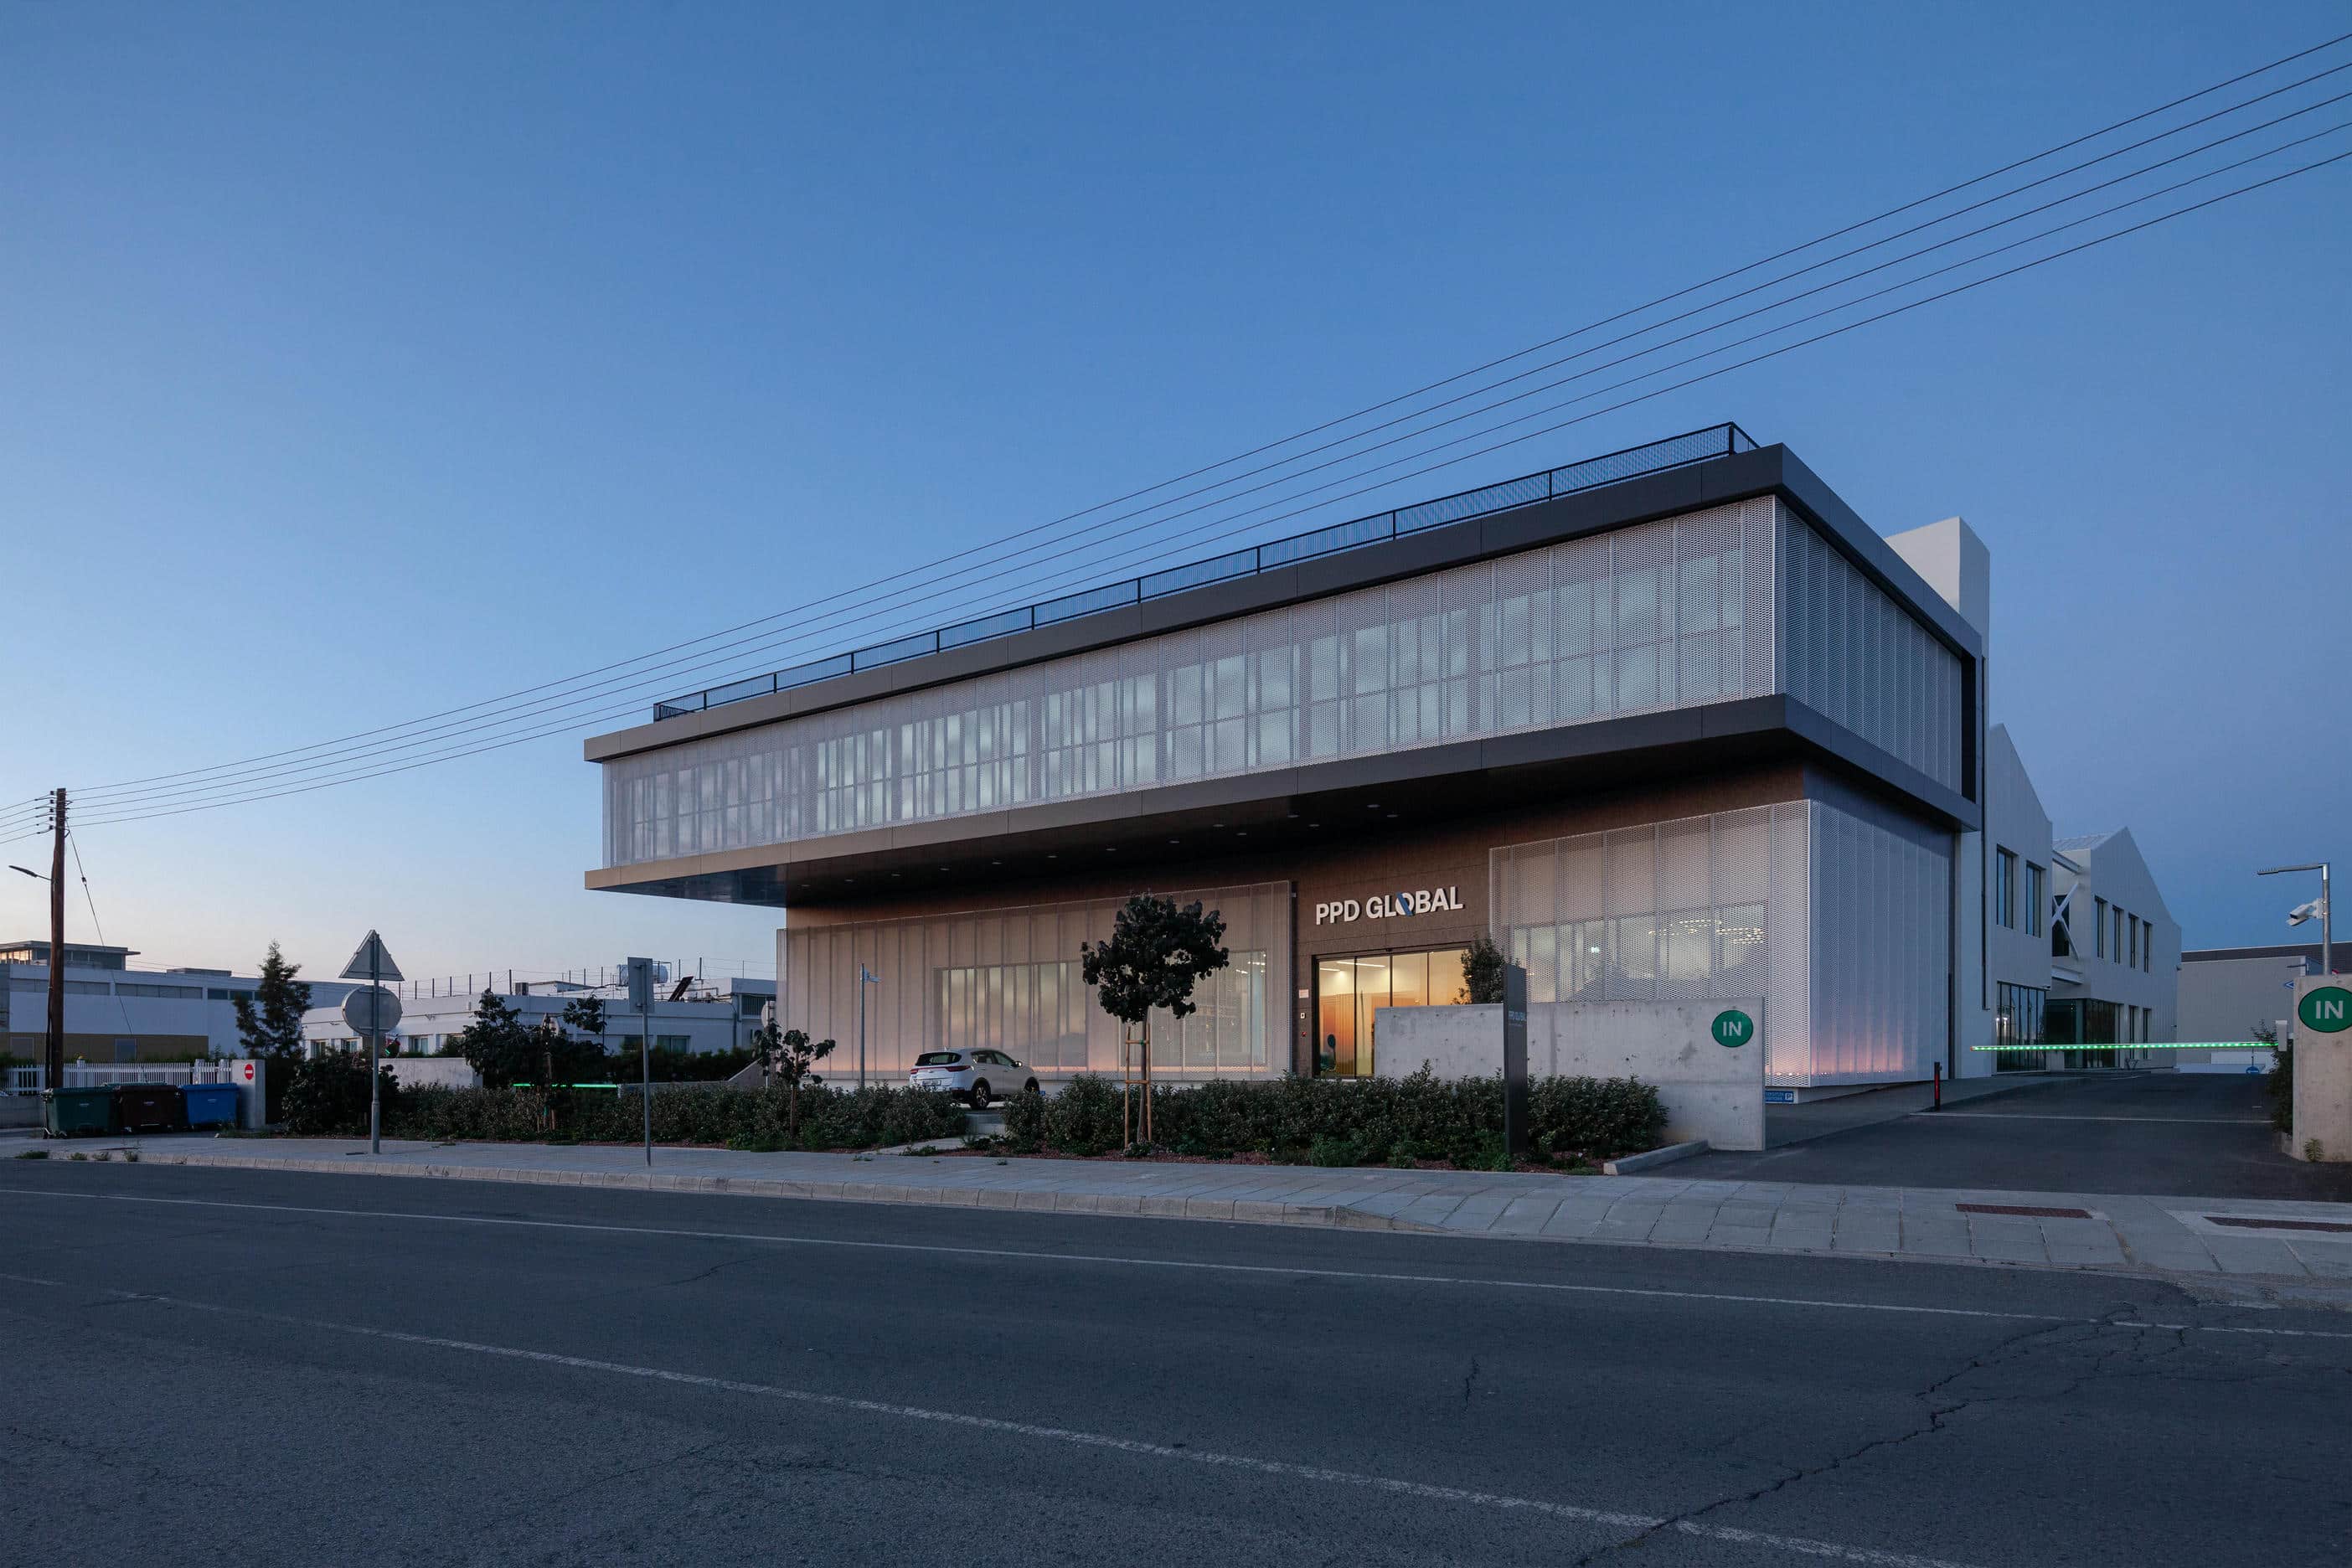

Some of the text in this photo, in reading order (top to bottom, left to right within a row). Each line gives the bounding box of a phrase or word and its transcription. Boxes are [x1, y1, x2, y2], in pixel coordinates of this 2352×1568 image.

[1316, 885, 1464, 925] PPD GLOBAL
[2315, 1000, 2344, 1019] IN
[1723, 1021, 1742, 1037] IN
